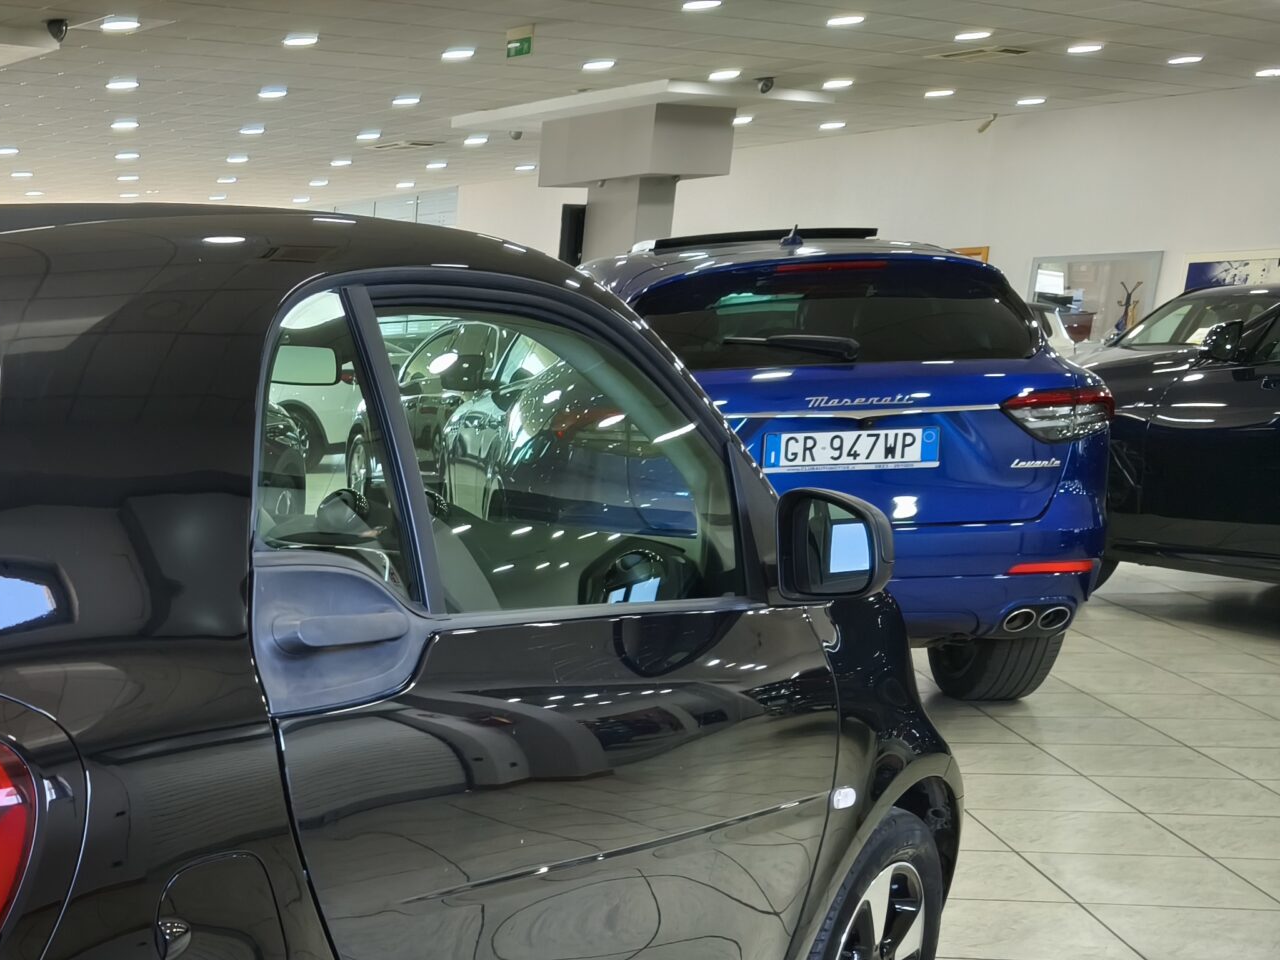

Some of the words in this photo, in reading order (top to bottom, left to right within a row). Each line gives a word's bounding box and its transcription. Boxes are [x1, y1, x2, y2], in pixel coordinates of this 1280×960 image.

[804, 393, 914, 408] Maserati
[783, 434, 817, 463] GR
[829, 432, 916, 461] 947WP
[1010, 457, 1061, 468] Levante
